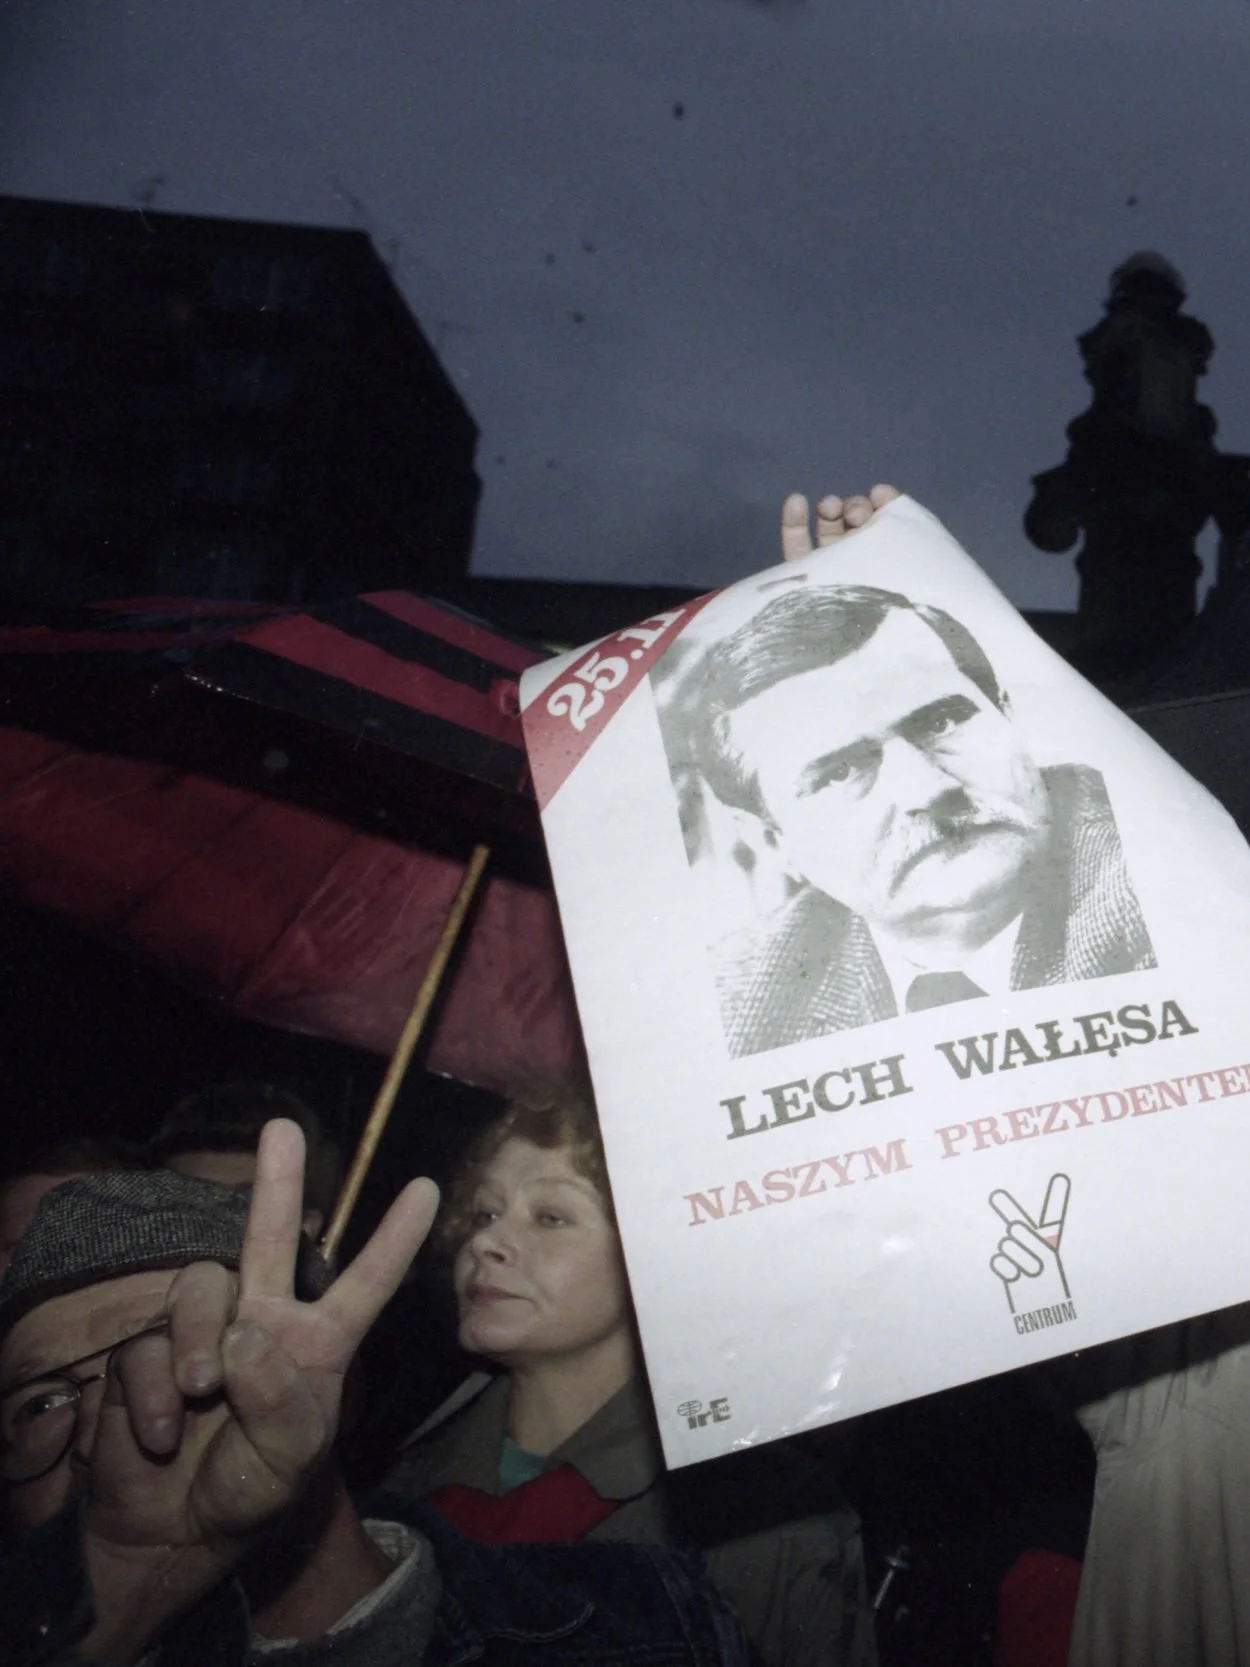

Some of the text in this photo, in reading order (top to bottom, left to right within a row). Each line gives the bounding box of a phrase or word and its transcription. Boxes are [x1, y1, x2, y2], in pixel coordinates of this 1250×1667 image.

[720, 1000, 1198, 1140] LECH WAŁĘSA
[683, 1139, 913, 1226] NASZYM
[1013, 1300, 1078, 1336] CENTRUM
